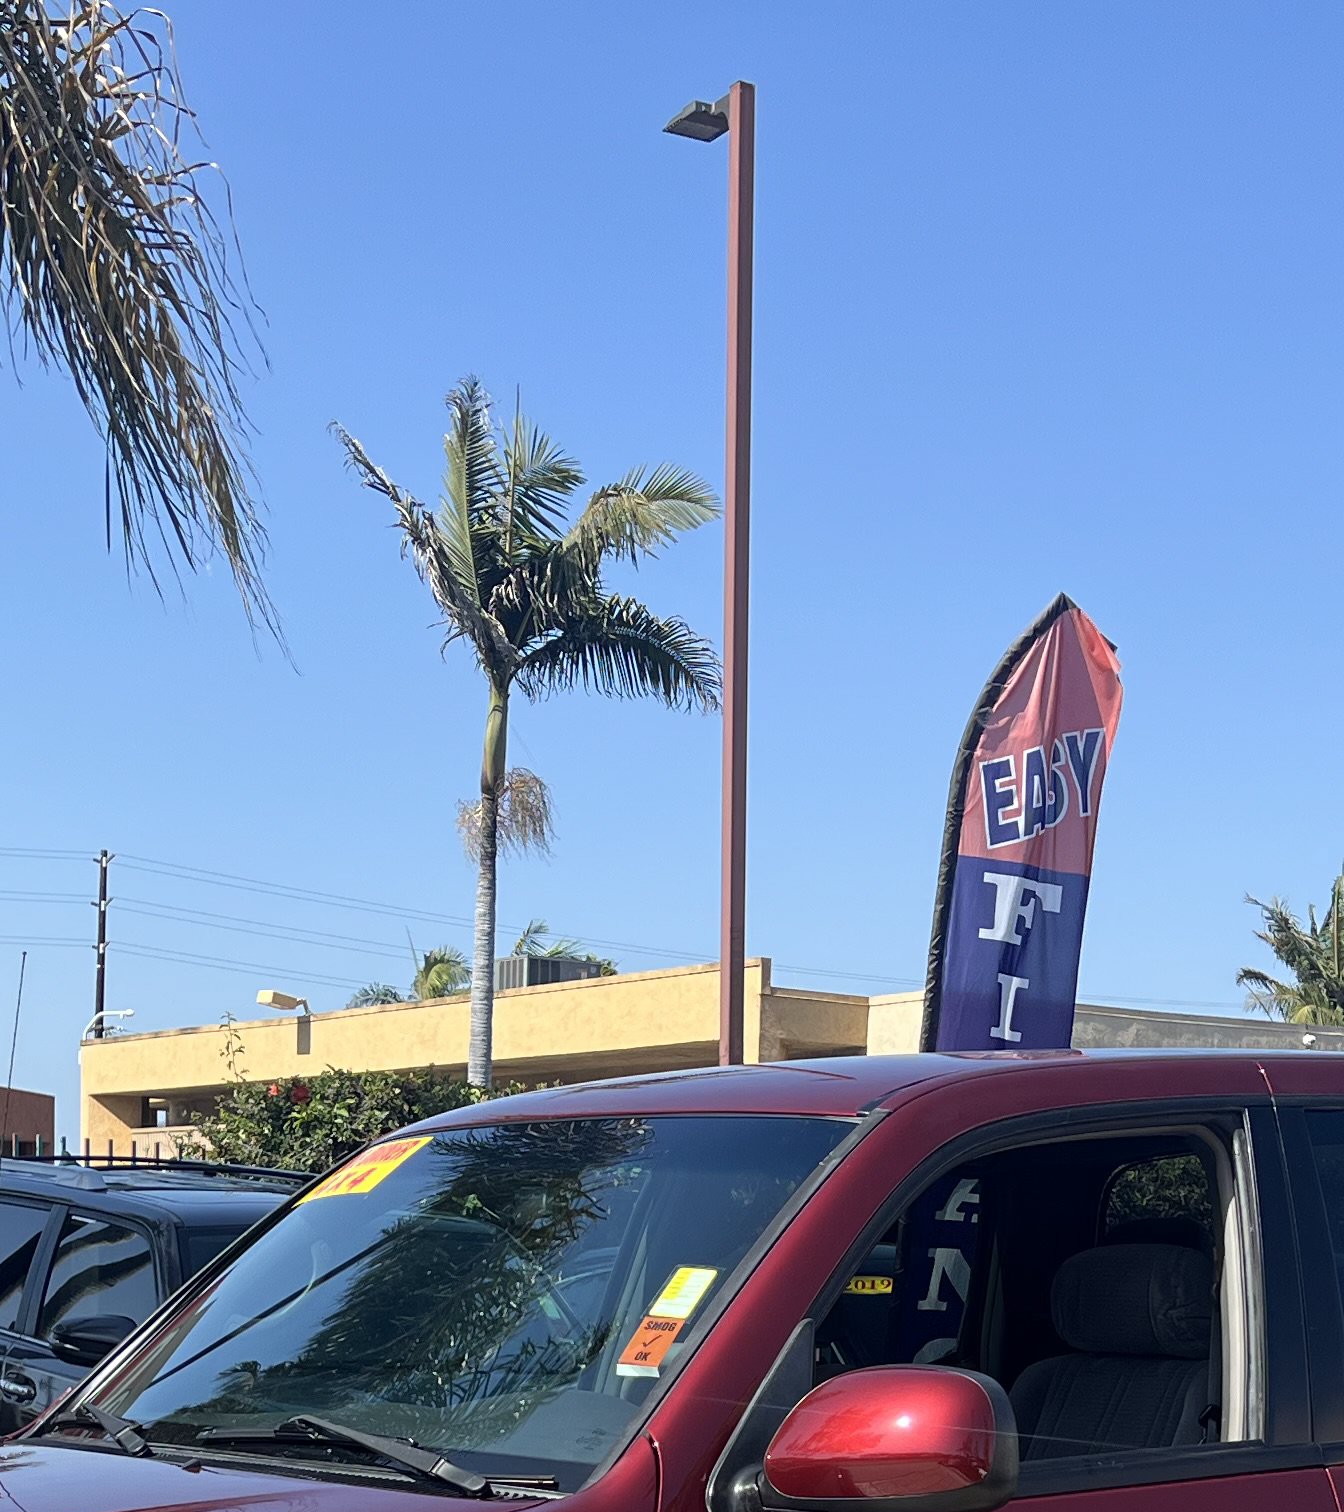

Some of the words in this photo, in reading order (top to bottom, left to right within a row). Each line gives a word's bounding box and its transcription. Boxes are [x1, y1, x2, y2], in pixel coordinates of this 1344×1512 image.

[979, 727, 1106, 850] EASY
[644, 1320, 678, 1332] SMOG
[634, 1351, 652, 1361] OK
